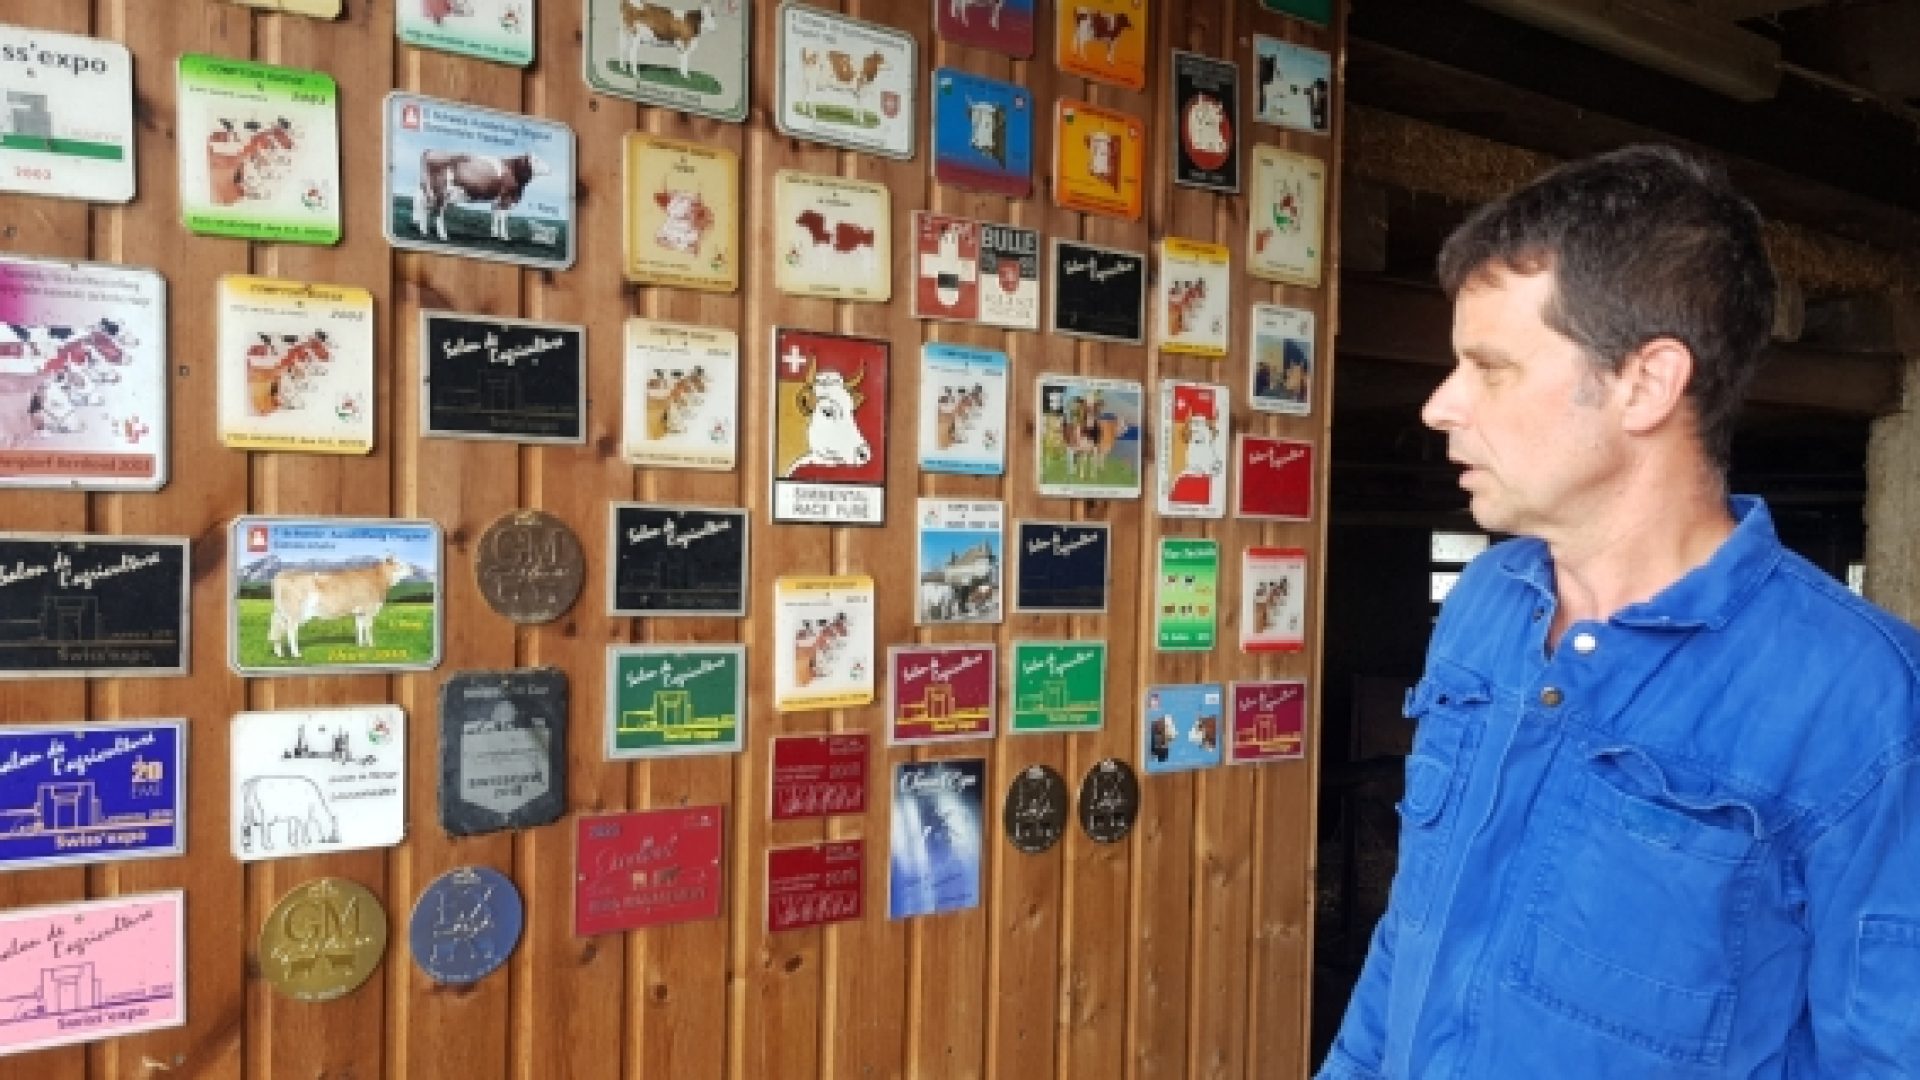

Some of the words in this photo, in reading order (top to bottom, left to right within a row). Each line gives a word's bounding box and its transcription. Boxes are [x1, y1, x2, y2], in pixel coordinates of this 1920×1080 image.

[983, 223, 1038, 250] BULLE
[442, 337, 483, 360] Salon
[795, 487, 865, 503] SIMMENTAL
[792, 502, 830, 516] RACE
[626, 524, 661, 546] Salon
[53, 551, 72, 573] de
[60, 551, 161, 589] l'agriculture
[625, 666, 658, 689] Salon
[47, 737, 69, 759] de
[53, 731, 157, 776] l'agriculture
[131, 761, 163, 783] 20
[56, 831, 148, 850] Swiss'expo
[282, 897, 362, 943] GM
[47, 924, 64, 942] de
[54, 910, 153, 959] l'agriculture
